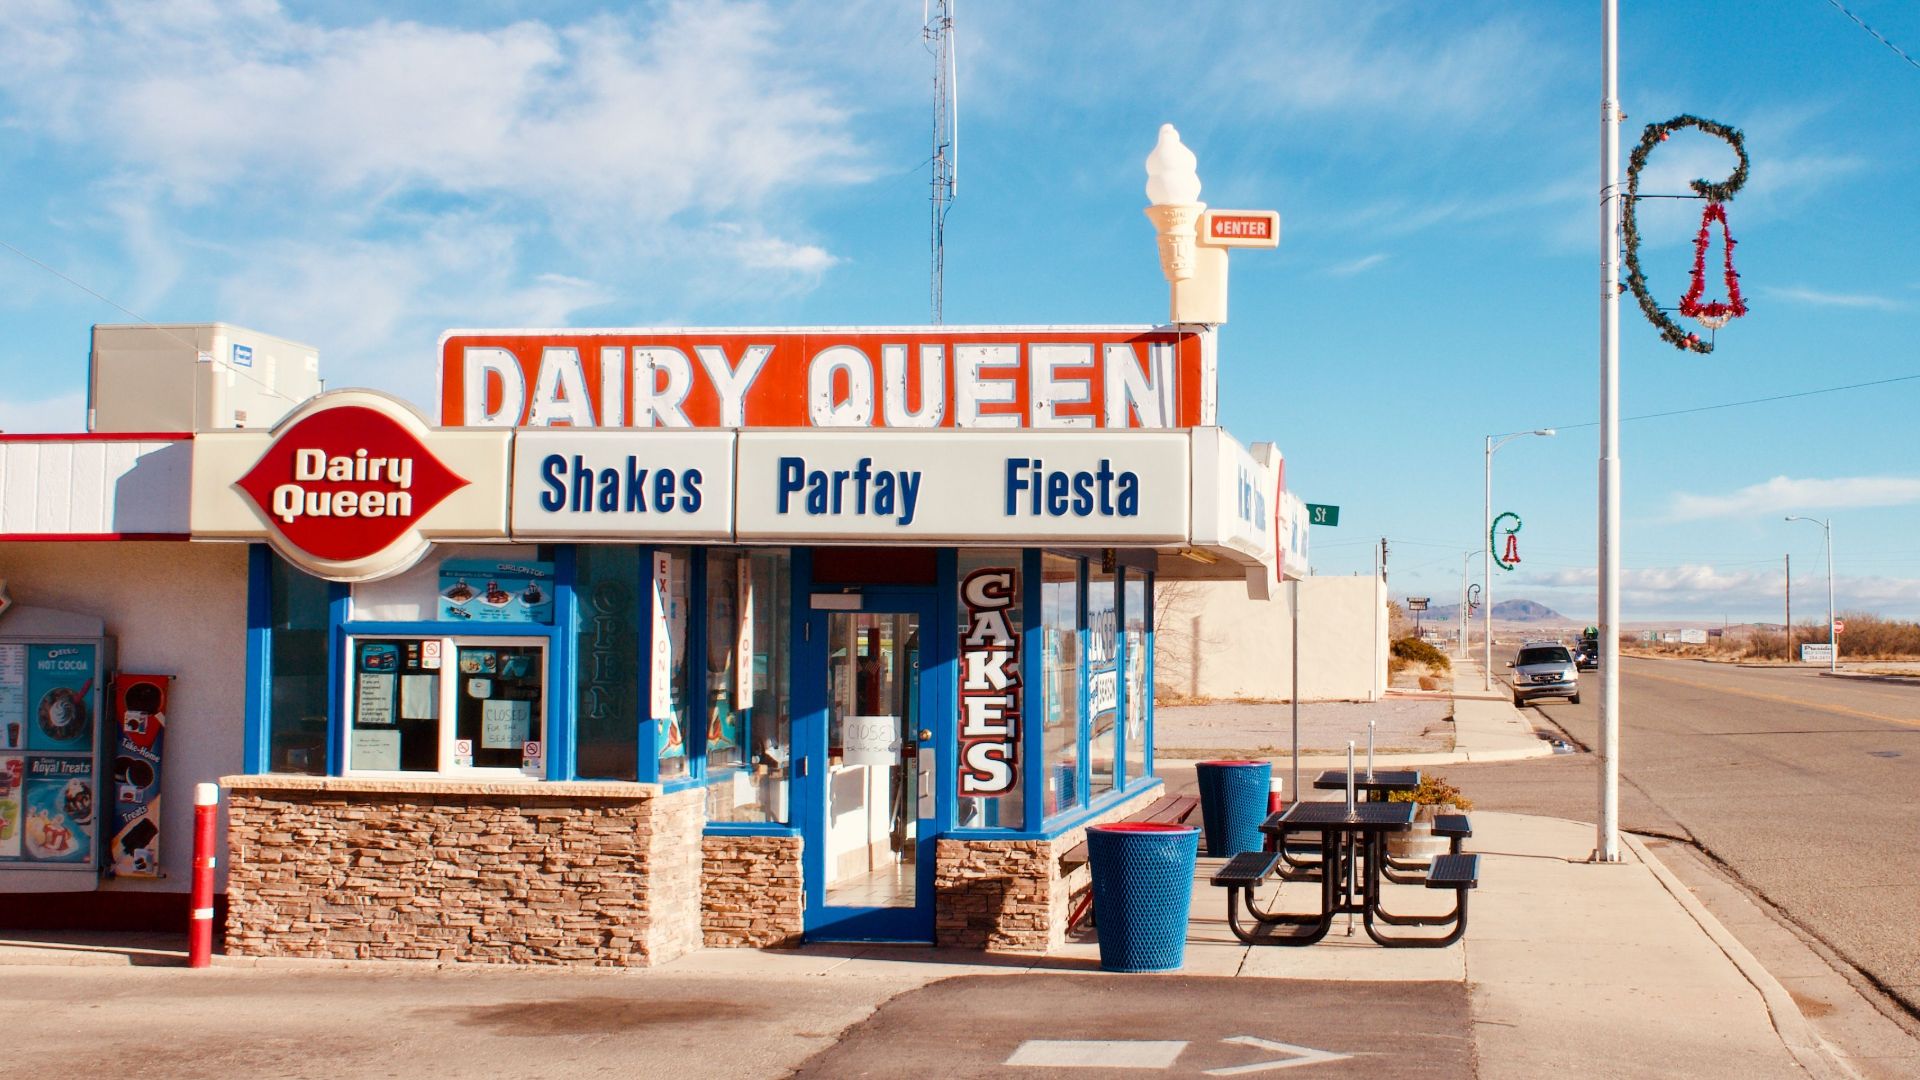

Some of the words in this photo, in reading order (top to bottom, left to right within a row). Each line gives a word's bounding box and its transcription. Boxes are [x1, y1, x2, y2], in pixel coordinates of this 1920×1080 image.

[1223, 220, 1266, 236] ENTER
[464, 345, 777, 427] DAIRY
[808, 342, 1176, 428] QUEEN
[295, 448, 413, 489] Dairy
[540, 454, 704, 513] Shakes
[1004, 457, 1140, 518] Fiesta
[273, 484, 412, 524] Queen
[776, 456, 923, 527] Parfay
[1313, 507, 1327, 523] St
[37, 660, 56, 671] HOT
[57, 660, 88, 671] COCOA
[590, 580, 627, 721] OPEN
[658, 639, 667, 711] ONLY
[960, 568, 1023, 797] CAKES
[486, 708, 528, 722] CLOSED
[32, 761, 59, 776] Royal
[61, 762, 91, 774] Treats
[122, 737, 161, 764] Take-Home
[122, 805, 148, 823] Treats
